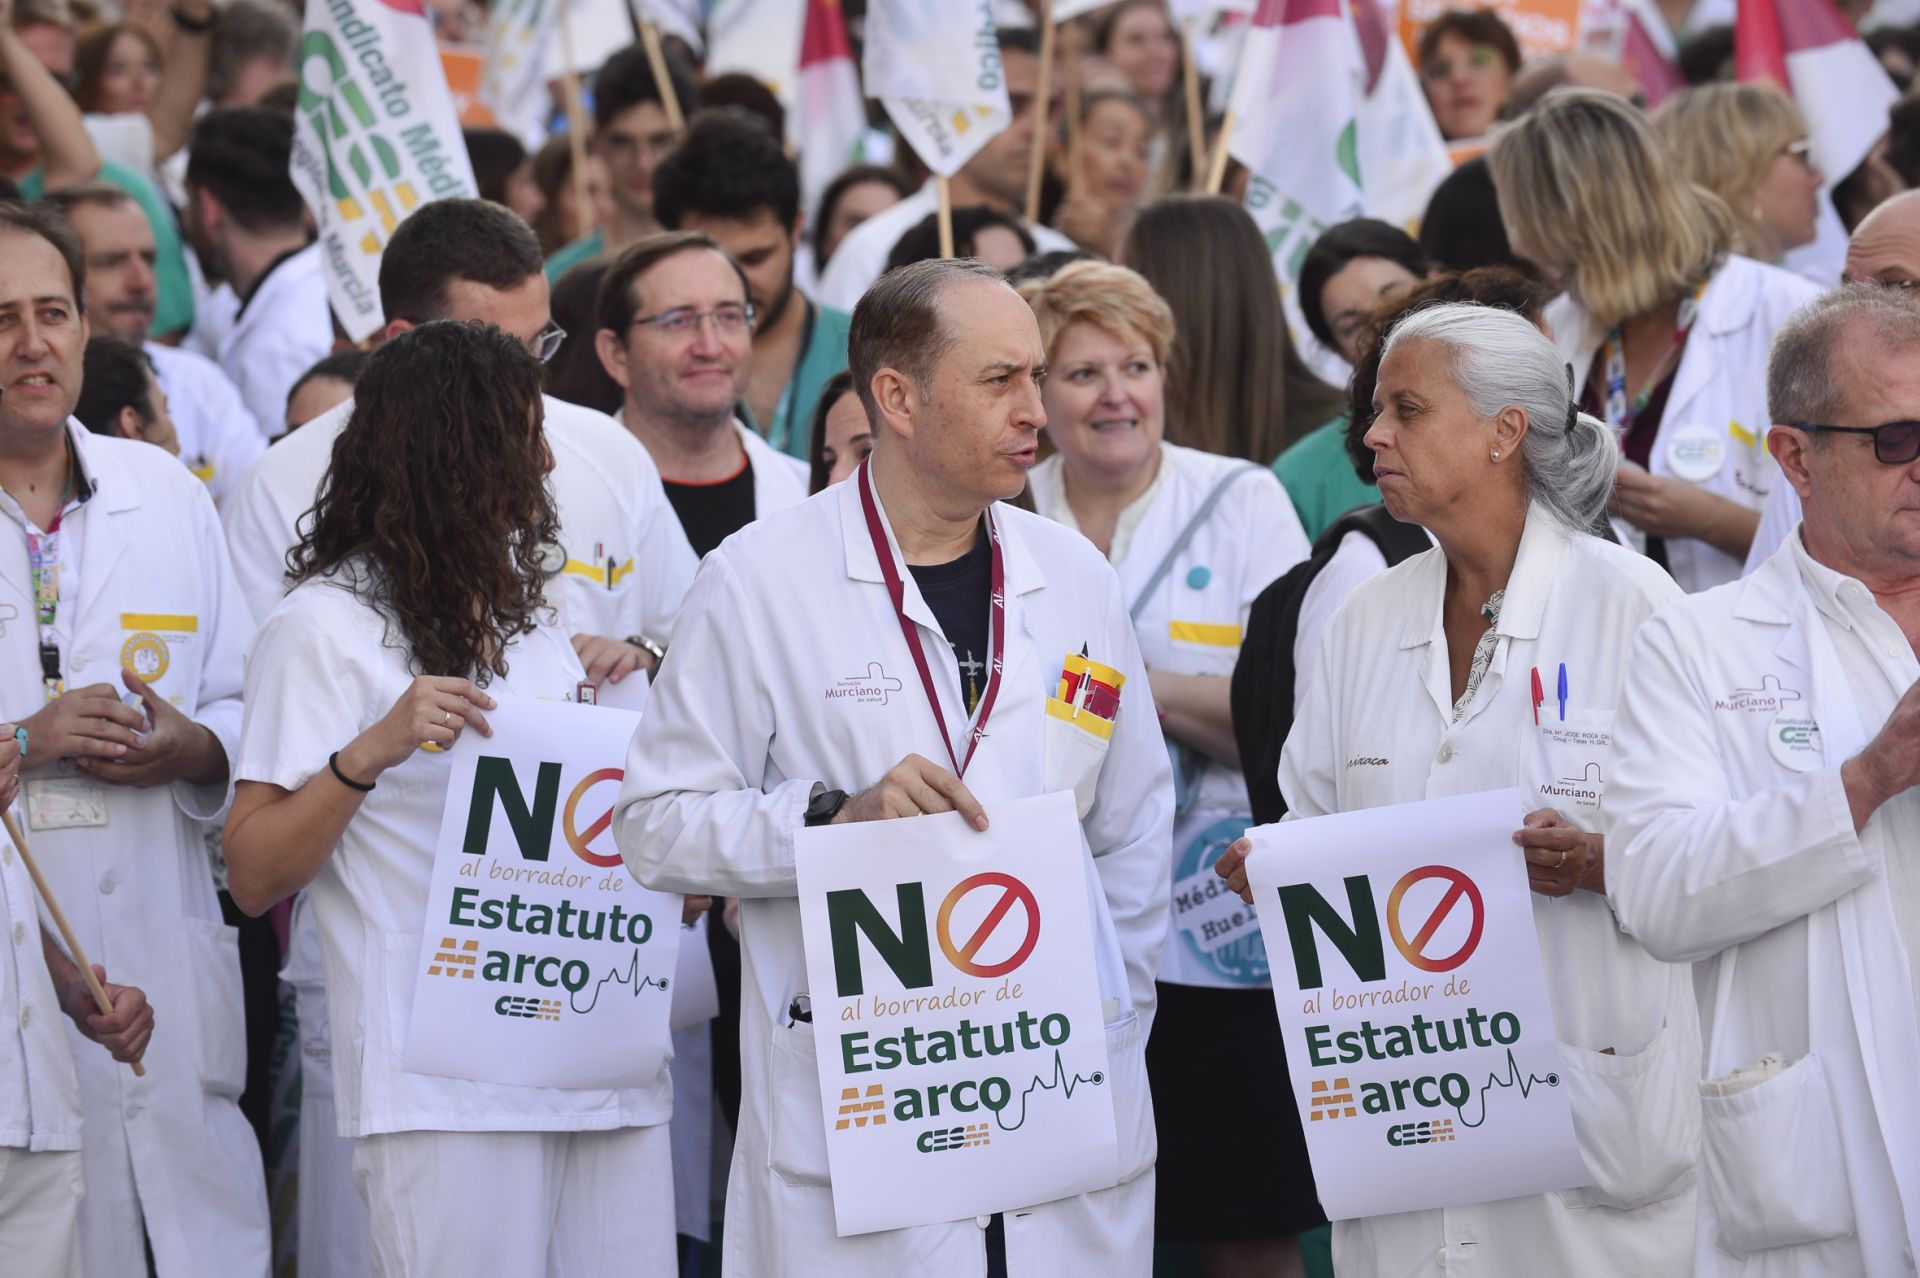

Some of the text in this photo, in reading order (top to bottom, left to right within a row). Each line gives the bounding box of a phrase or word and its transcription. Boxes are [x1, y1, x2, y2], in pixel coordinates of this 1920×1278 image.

[825, 686, 881, 699] Murciano
[1715, 697, 1776, 711] Murciano
[1540, 784, 1596, 799] Murciano
[459, 857, 623, 892] al borrador de
[449, 887, 653, 945] Estatuto
[427, 937, 591, 994] Marco
[494, 995, 562, 1022] CESM
[840, 979, 1025, 1022] al borrador de
[1303, 974, 1471, 1015] al borrador de
[841, 1010, 1071, 1074] Estatuto
[1305, 1007, 1521, 1067] Estatuto
[836, 1075, 1012, 1130] Marco
[1310, 1072, 1471, 1122] Marco
[916, 1123, 991, 1153] CESM
[1386, 1119, 1456, 1147] CESM
